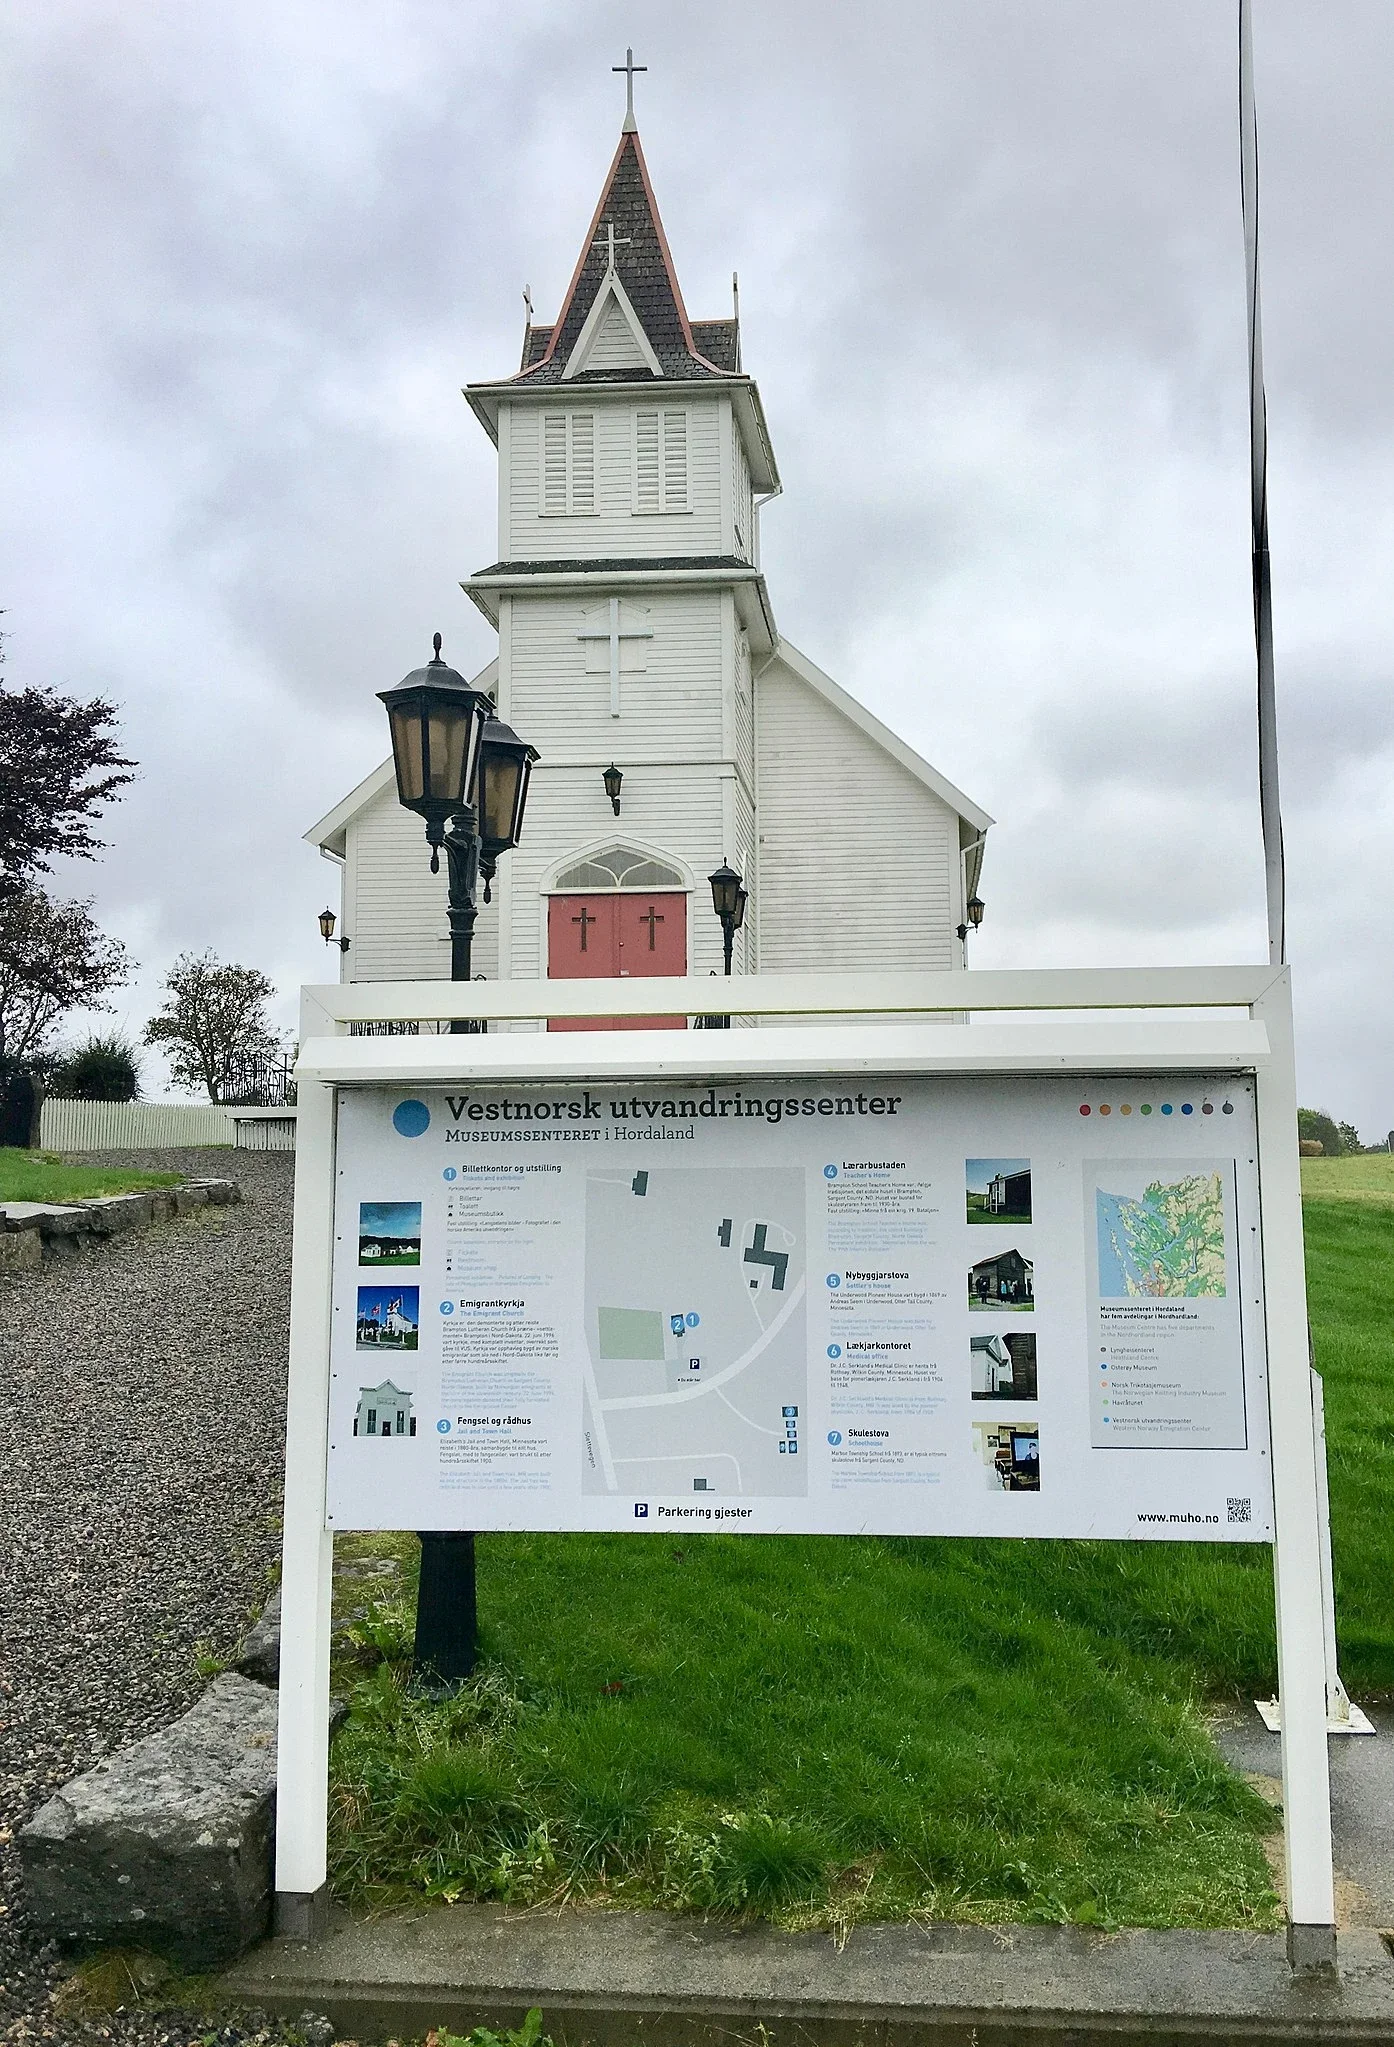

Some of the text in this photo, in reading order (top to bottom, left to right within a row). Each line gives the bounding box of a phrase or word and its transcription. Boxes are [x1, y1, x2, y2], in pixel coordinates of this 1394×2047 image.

[445, 1092, 902, 1123] Vestnorsk utvandringssenter
[445, 1125, 695, 1143] MUSEUMSSENTERET i Hordaland
[526, 1164, 561, 1173] utstilling
[846, 1271, 909, 1280] Nybyggjarstova
[830, 1277, 836, 1285] 5
[444, 1304, 449, 1312] 2
[460, 1300, 524, 1308] Emigrantkyrkja
[674, 1319, 681, 1330] 2
[831, 1347, 837, 1355] 6
[847, 1342, 911, 1351] Lækjarkontoret
[458, 1417, 489, 1426] Fengsel
[503, 1416, 531, 1424] rådhus
[441, 1422, 446, 1430] 3
[849, 1429, 889, 1437] Skulestova
[832, 1433, 837, 1443] 7
[658, 1507, 752, 1519] Parkering gjester
[1138, 1513, 1219, 1523] www.muho.no
